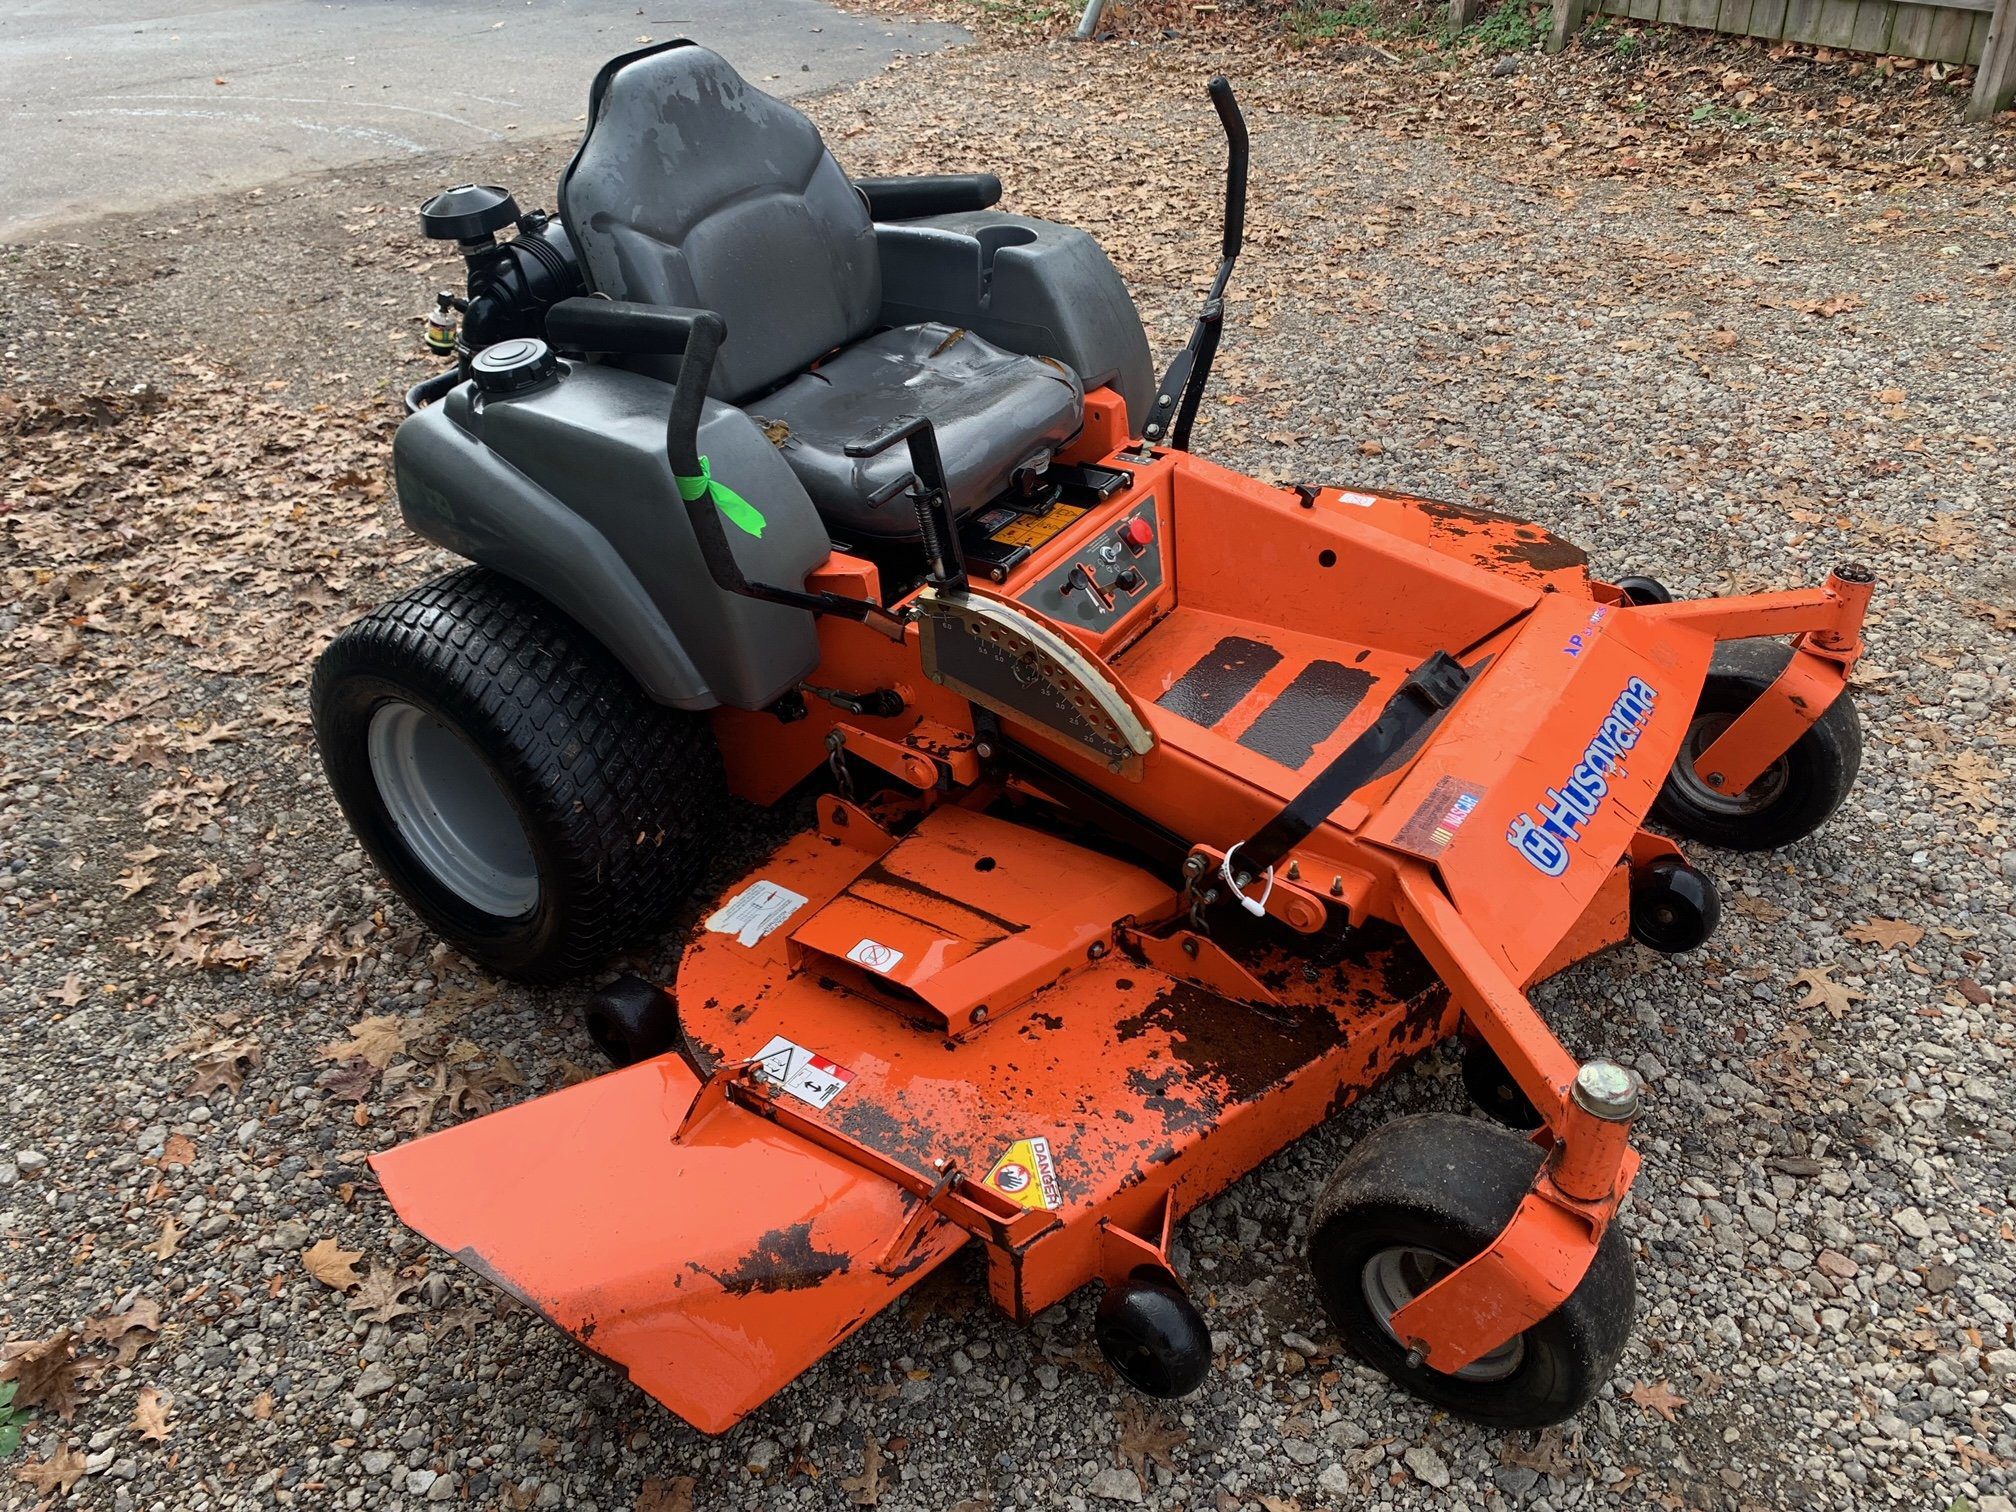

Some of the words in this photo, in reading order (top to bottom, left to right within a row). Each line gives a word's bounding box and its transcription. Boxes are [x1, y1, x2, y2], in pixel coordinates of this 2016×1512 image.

[1041, 688, 1051, 696] 3.5
[1056, 702, 1065, 710] 3.0
[1069, 717, 1079, 726] 2.5
[1084, 735, 1094, 743] 2.0
[1536, 675, 1659, 842] Husqvarna
[1442, 794, 1479, 827] NASCAR
[1034, 1143, 1058, 1205] DANGER
